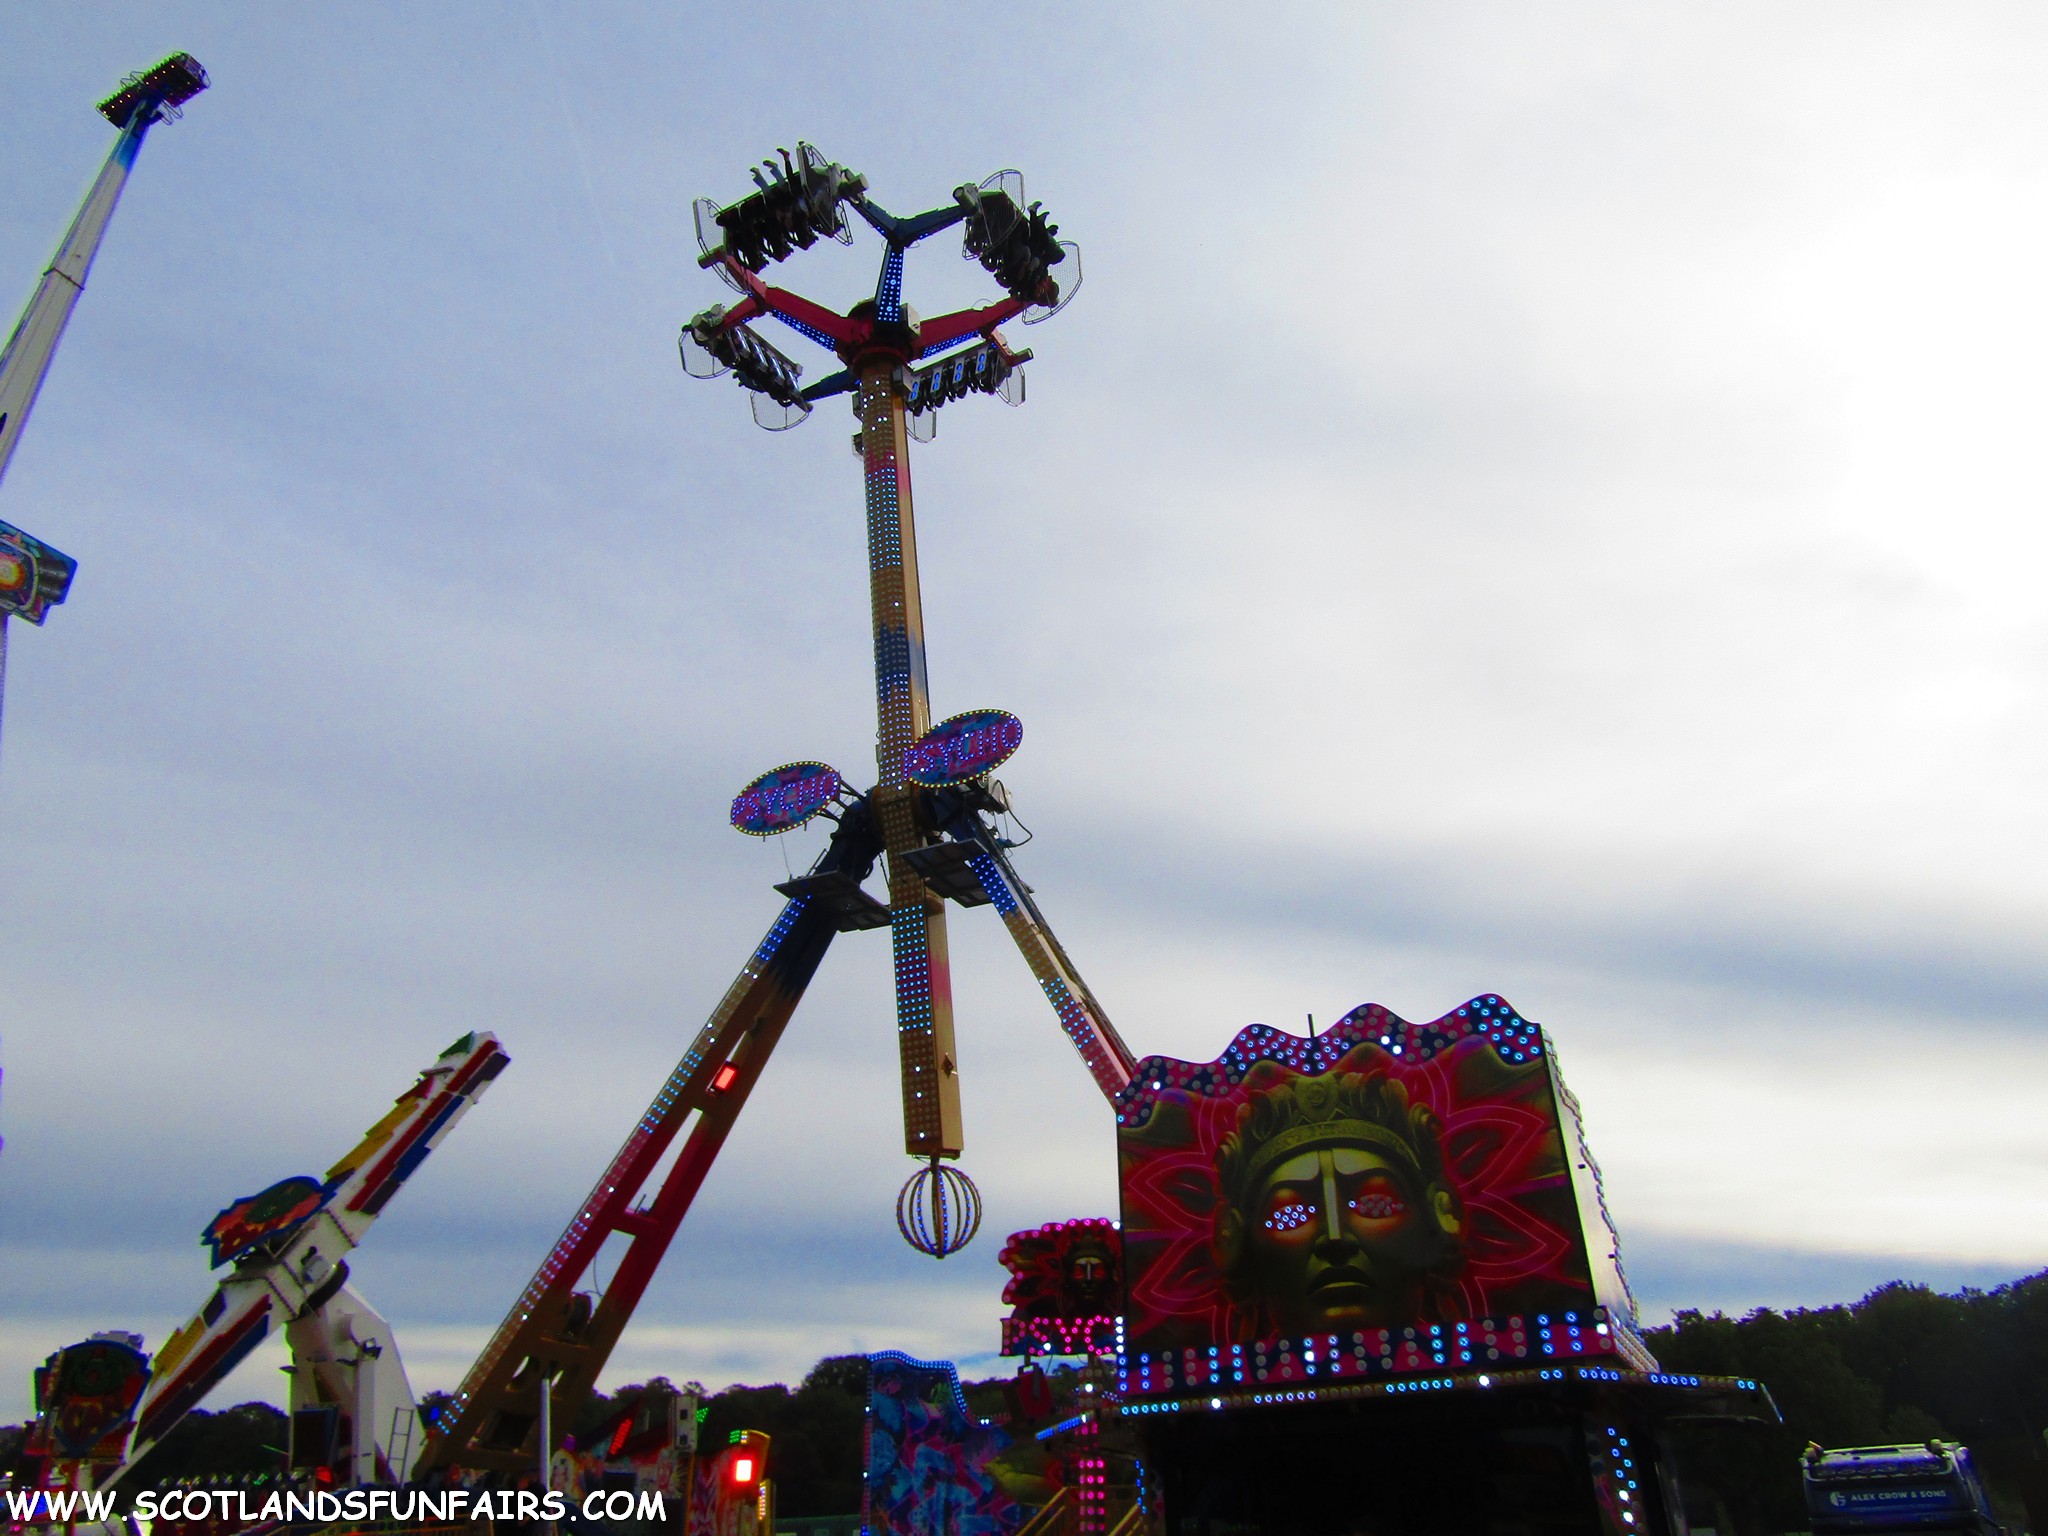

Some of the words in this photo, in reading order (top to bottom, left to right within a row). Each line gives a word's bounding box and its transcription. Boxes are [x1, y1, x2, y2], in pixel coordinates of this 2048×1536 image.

[902, 718, 1023, 780] PSYCHO
[730, 771, 839, 825] PSYCHO
[1851, 1493, 1876, 1501] ALEX
[1878, 1491, 1908, 1500] CROW
[1920, 1489, 1947, 1498] SONS
